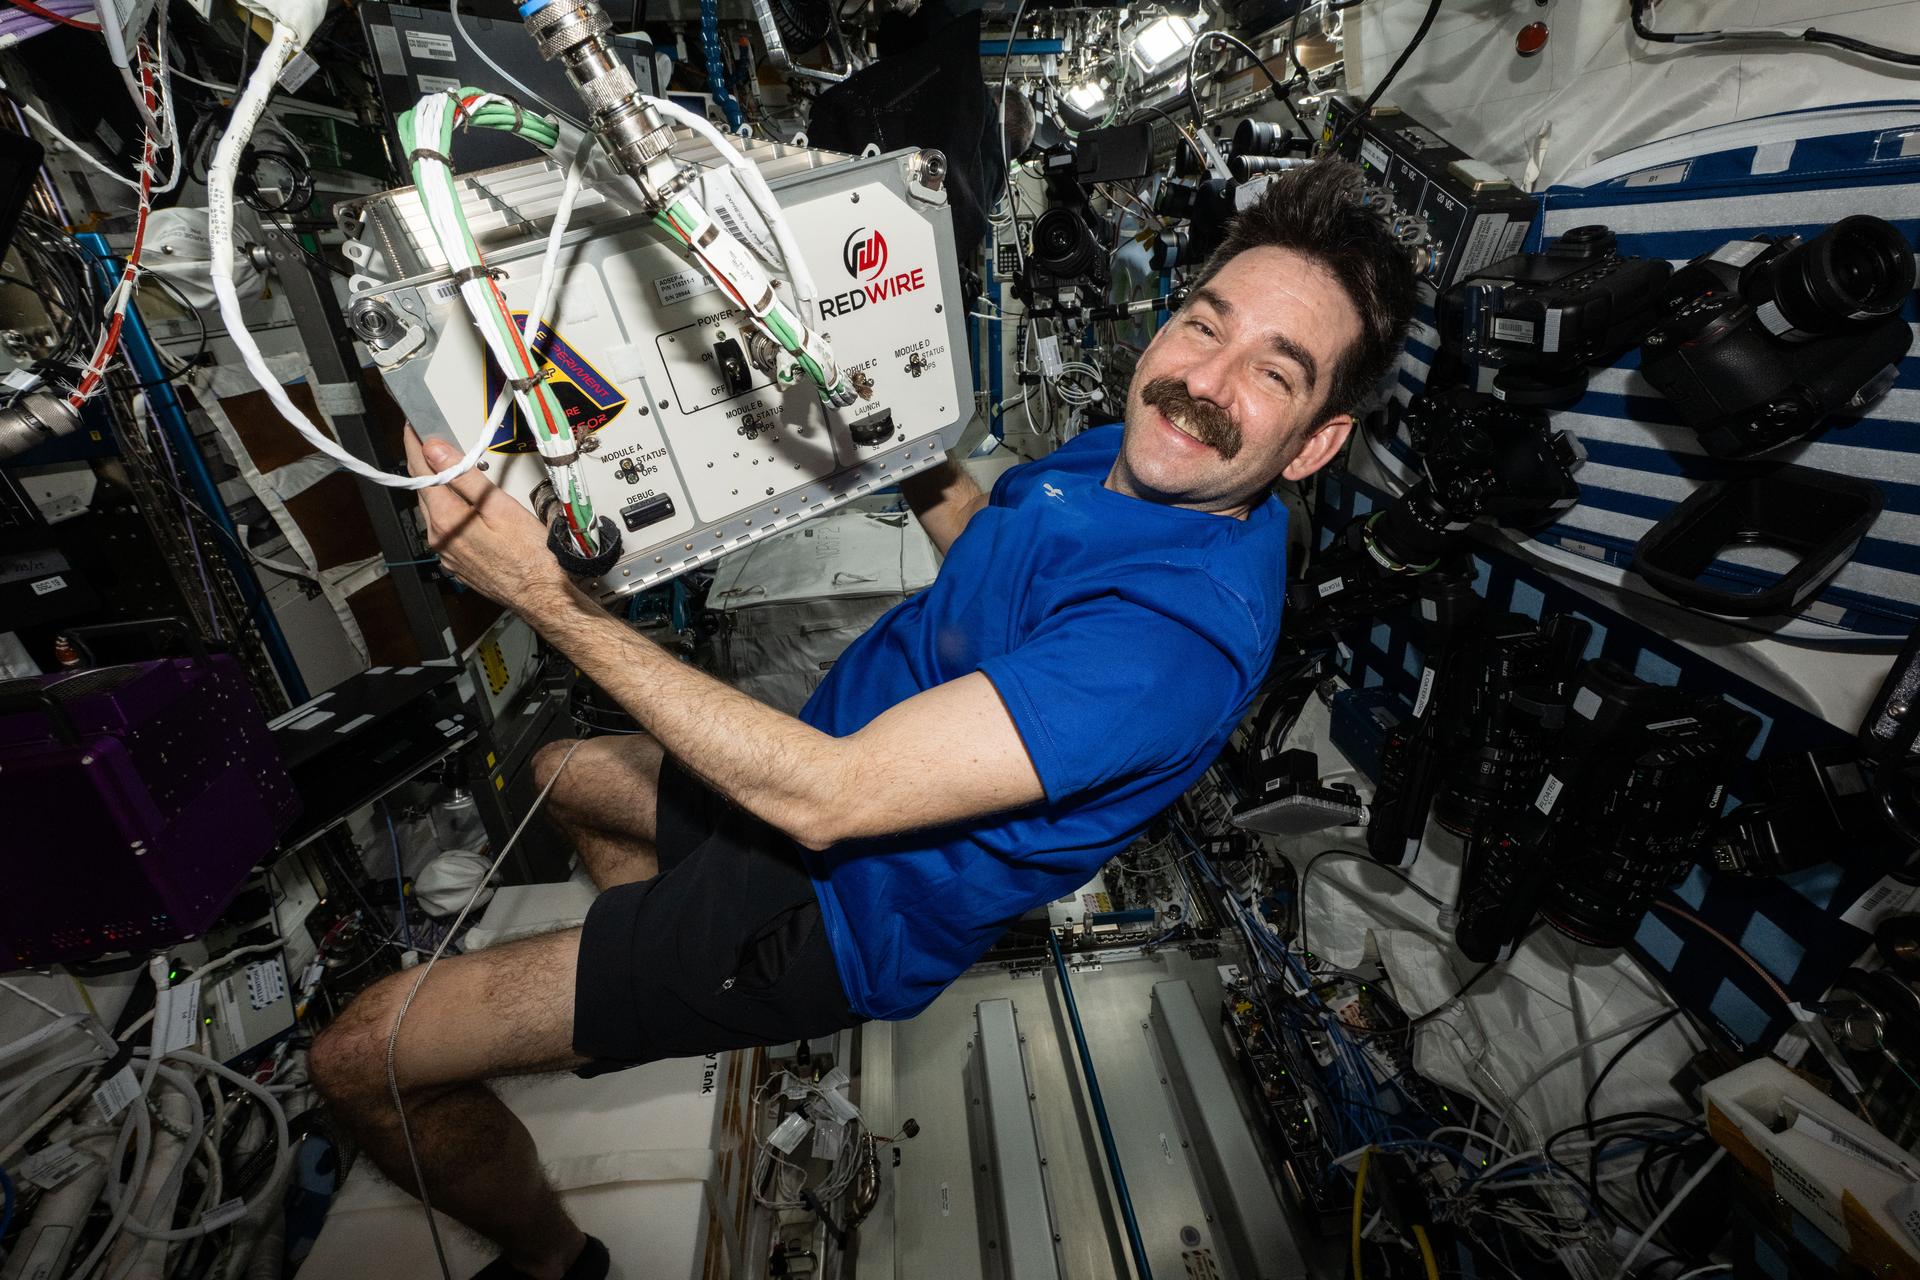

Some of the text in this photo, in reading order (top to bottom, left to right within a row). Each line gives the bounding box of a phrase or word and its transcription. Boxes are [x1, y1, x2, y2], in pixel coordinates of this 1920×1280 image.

[1648, 174, 1659, 184] B1
[725, 194, 746, 222] EXPRESS
[818, 268, 925, 320] REDWIRE
[697, 309, 734, 327] POWER
[701, 352, 714, 362] ON
[894, 338, 931, 359] MODULE D
[921, 345, 946, 359] STATUS
[871, 358, 878, 367] C
[710, 384, 726, 396] OFF
[726, 400, 764, 419] MODULE B
[756, 405, 784, 421] STATUS
[854, 401, 882, 416] LAUNCH
[600, 444, 644, 464] MODULE A
[636, 448, 668, 464] STATUS
[642, 465, 658, 477] OPS
[626, 489, 655, 505] DEBUG
[1420, 670, 1432, 700] FLOATER
[1538, 778, 1558, 812] FLOATER
[1709, 785, 1723, 809] Canon
[702, 1062, 718, 1095] Tank
